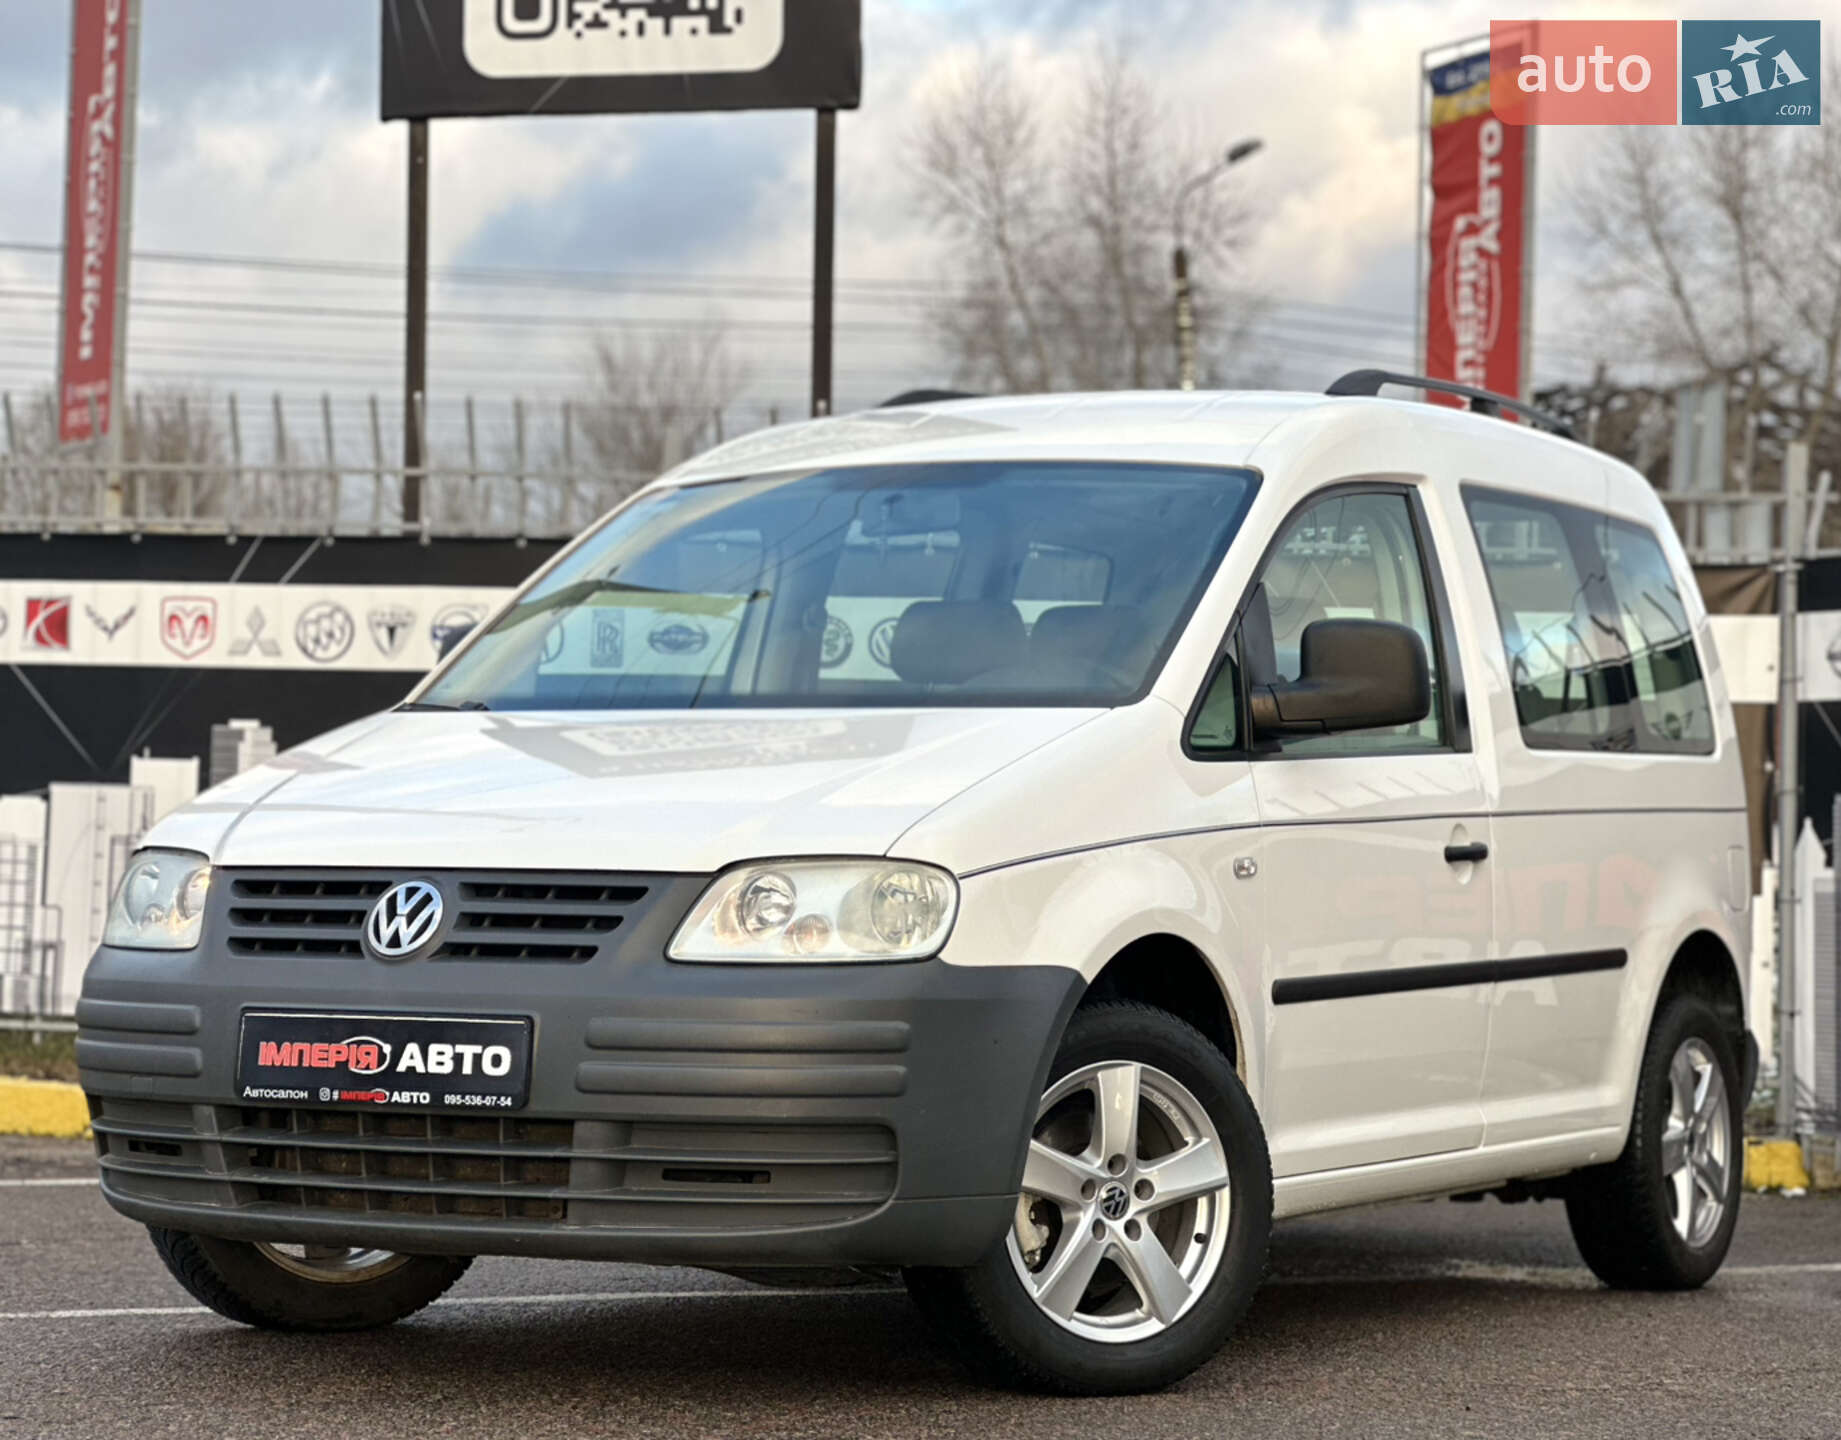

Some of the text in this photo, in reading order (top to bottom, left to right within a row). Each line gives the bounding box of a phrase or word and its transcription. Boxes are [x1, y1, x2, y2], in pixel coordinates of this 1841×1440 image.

[1478, 117, 1503, 255] АВТО
[258, 1041, 511, 1076] ІМПЕРІЯ АВТО
[243, 1086, 308, 1099] Автосалон
[391, 1091, 430, 1104] АВТО
[444, 1094, 512, 1107] 095-536-07-54
